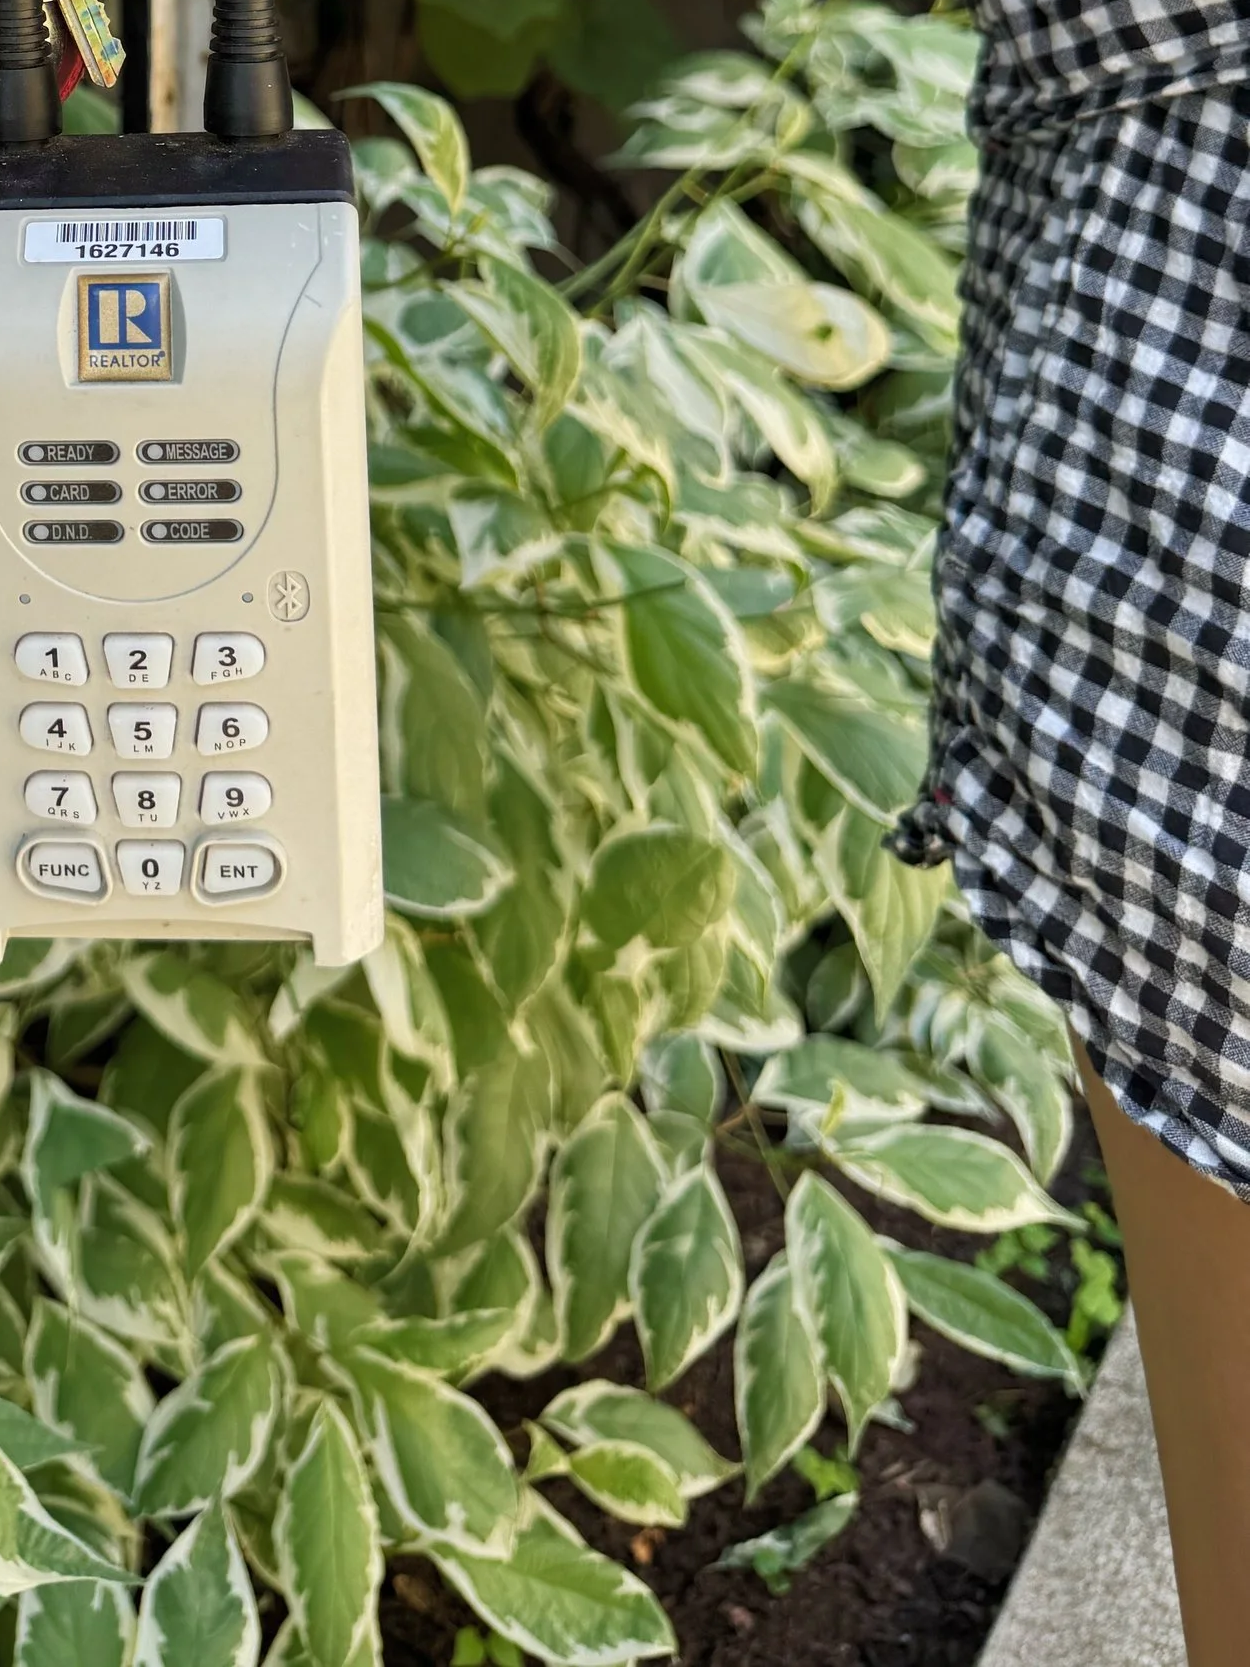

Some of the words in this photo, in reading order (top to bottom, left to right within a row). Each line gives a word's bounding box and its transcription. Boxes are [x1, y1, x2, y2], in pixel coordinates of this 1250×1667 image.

[75, 242, 180, 259] 1627146
[46, 445, 96, 462] READY
[166, 443, 228, 460] MESSAGE
[50, 485, 90, 501] CARD
[167, 483, 218, 500] ERROR
[51, 524, 93, 541] D.N.D.
[169, 523, 210, 540] CODE
[44, 647, 59, 668] 1
[128, 649, 148, 671] 2
[218, 646, 237, 667] 3
[47, 718, 68, 738] 4
[133, 721, 153, 741] 5
[221, 717, 241, 738] 6
[50, 786, 69, 807] 7
[137, 790, 156, 810] 8
[225, 787, 244, 807] 9
[39, 864, 90, 877] FUNC
[141, 858, 160, 879] 0
[220, 865, 258, 879] ENT
